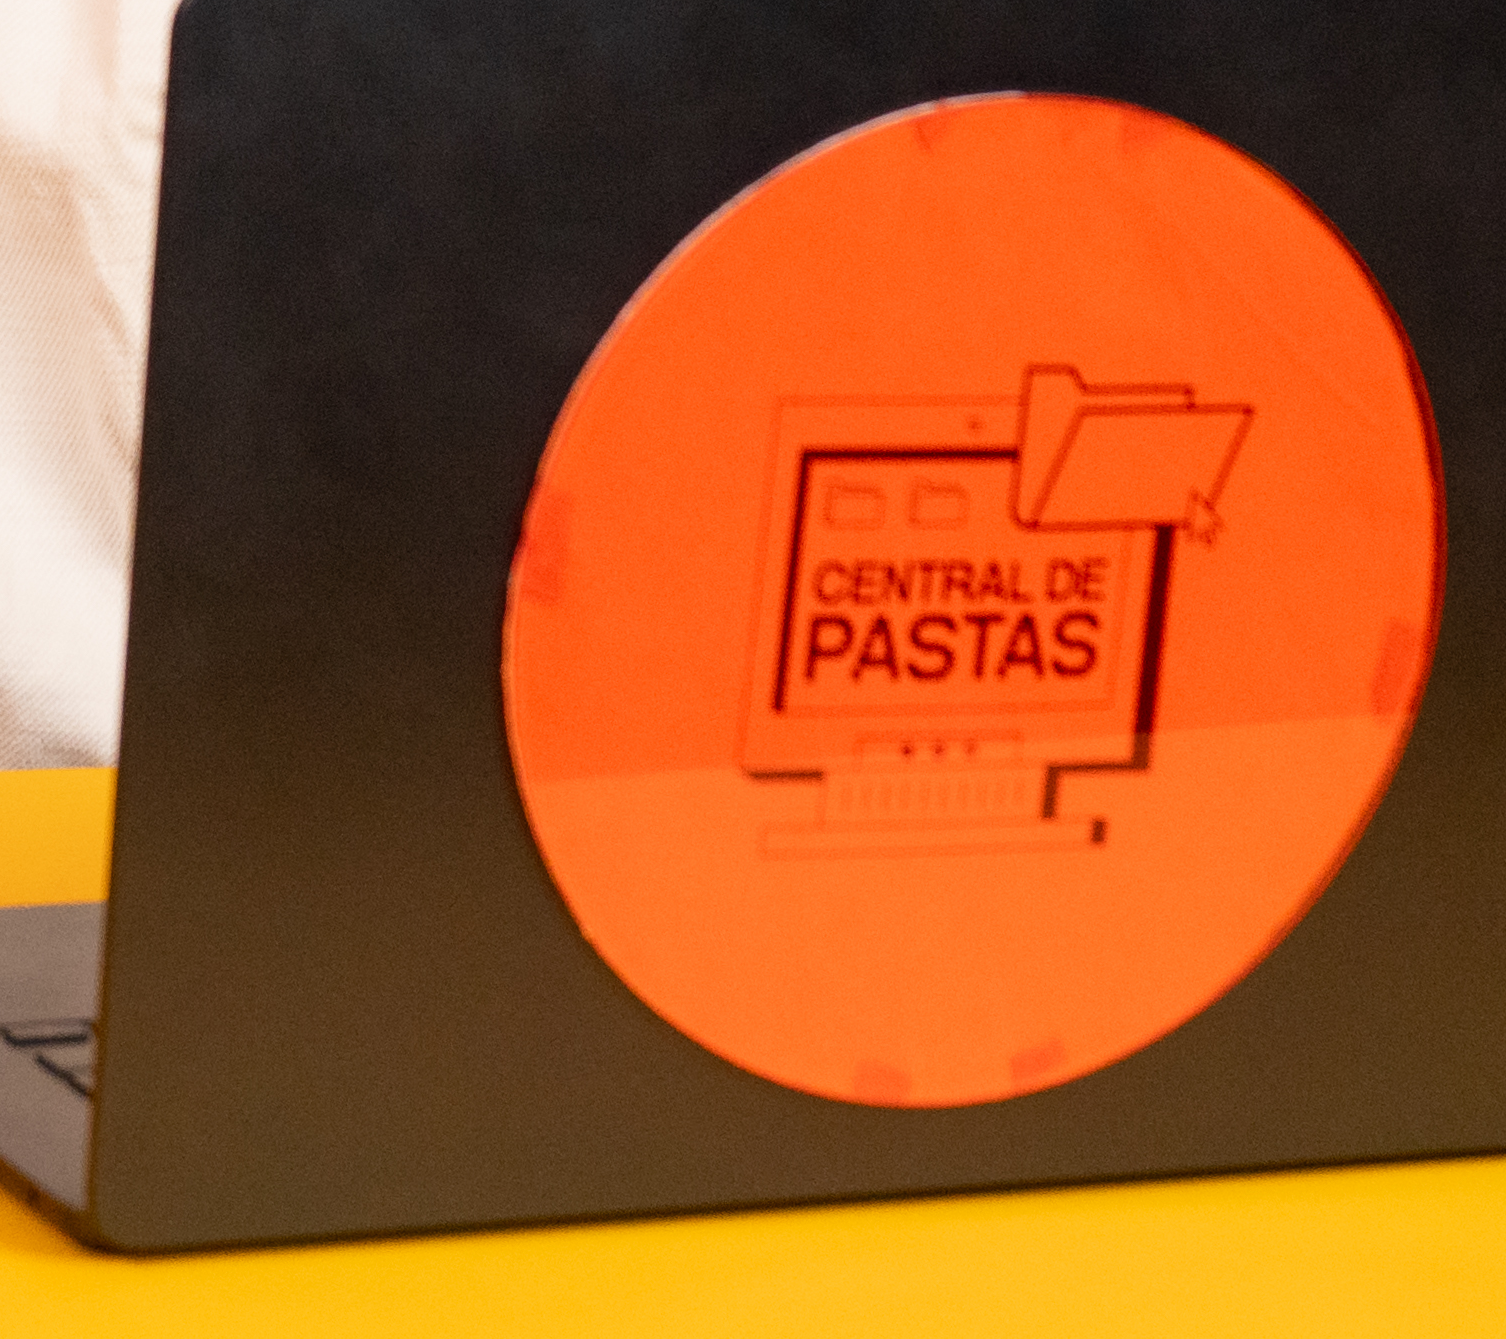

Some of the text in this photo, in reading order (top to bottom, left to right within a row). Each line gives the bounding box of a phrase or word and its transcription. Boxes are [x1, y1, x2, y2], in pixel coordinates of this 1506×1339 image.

[813, 557, 1110, 604] CENTRAL DE
[804, 609, 1102, 682] PASTAS
